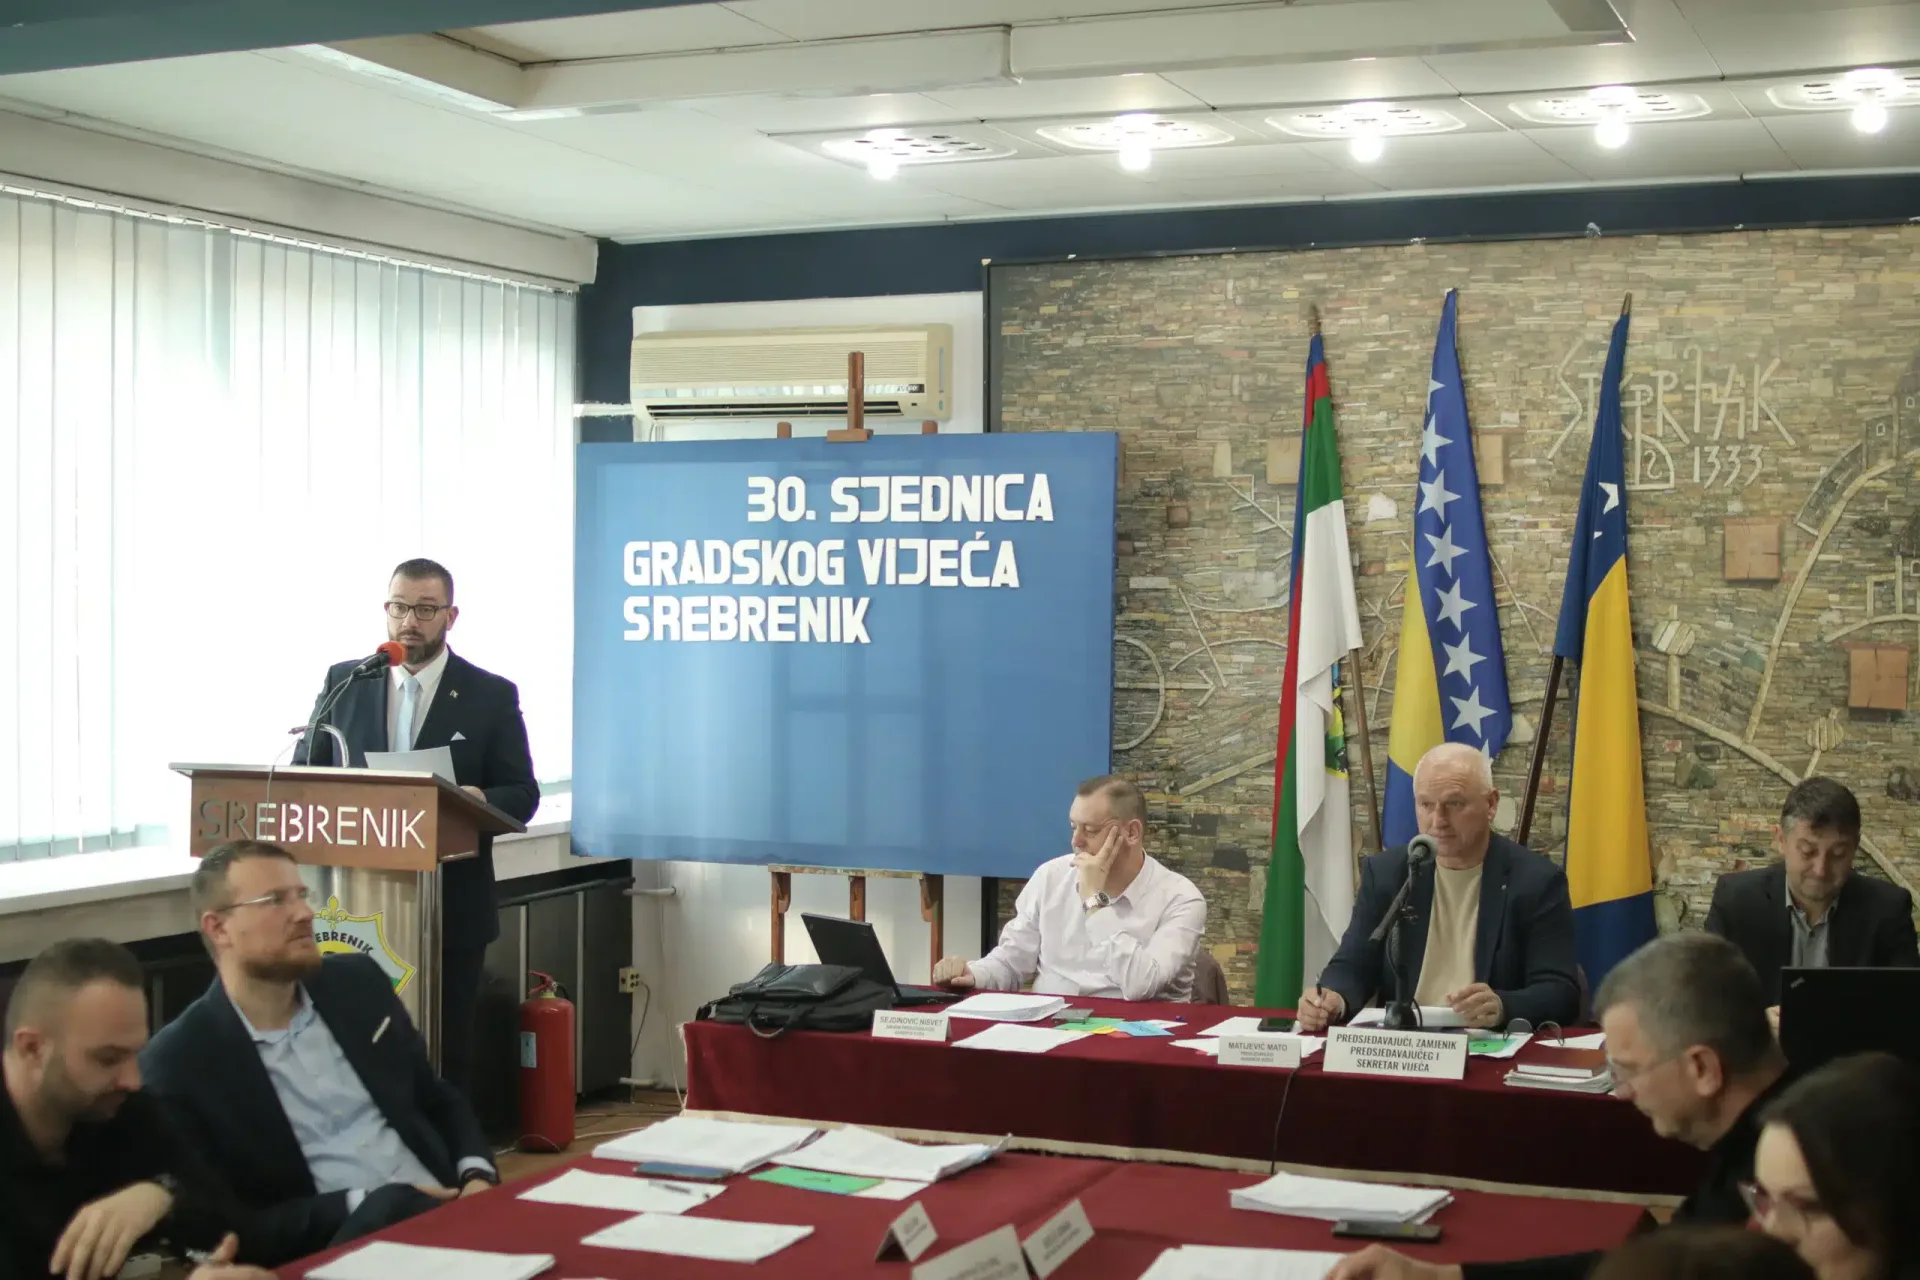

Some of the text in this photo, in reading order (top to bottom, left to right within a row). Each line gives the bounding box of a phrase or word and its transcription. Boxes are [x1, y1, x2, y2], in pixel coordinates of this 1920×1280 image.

[748, 473, 1054, 523] 30. SJEDNICA
[623, 531, 1020, 588] GRADSKOG VIJEĆA
[623, 595, 871, 645] SREBRENIK
[198, 799, 427, 849] SREBRENIK
[1267, 1043, 1288, 1051] MATO
[1350, 1046, 1434, 1060] PREDSJEDAVAJUĆEG
[1416, 1039, 1457, 1050] ZAMJENIK
[1356, 1059, 1430, 1072] SEKRETAR VIJEĆA
